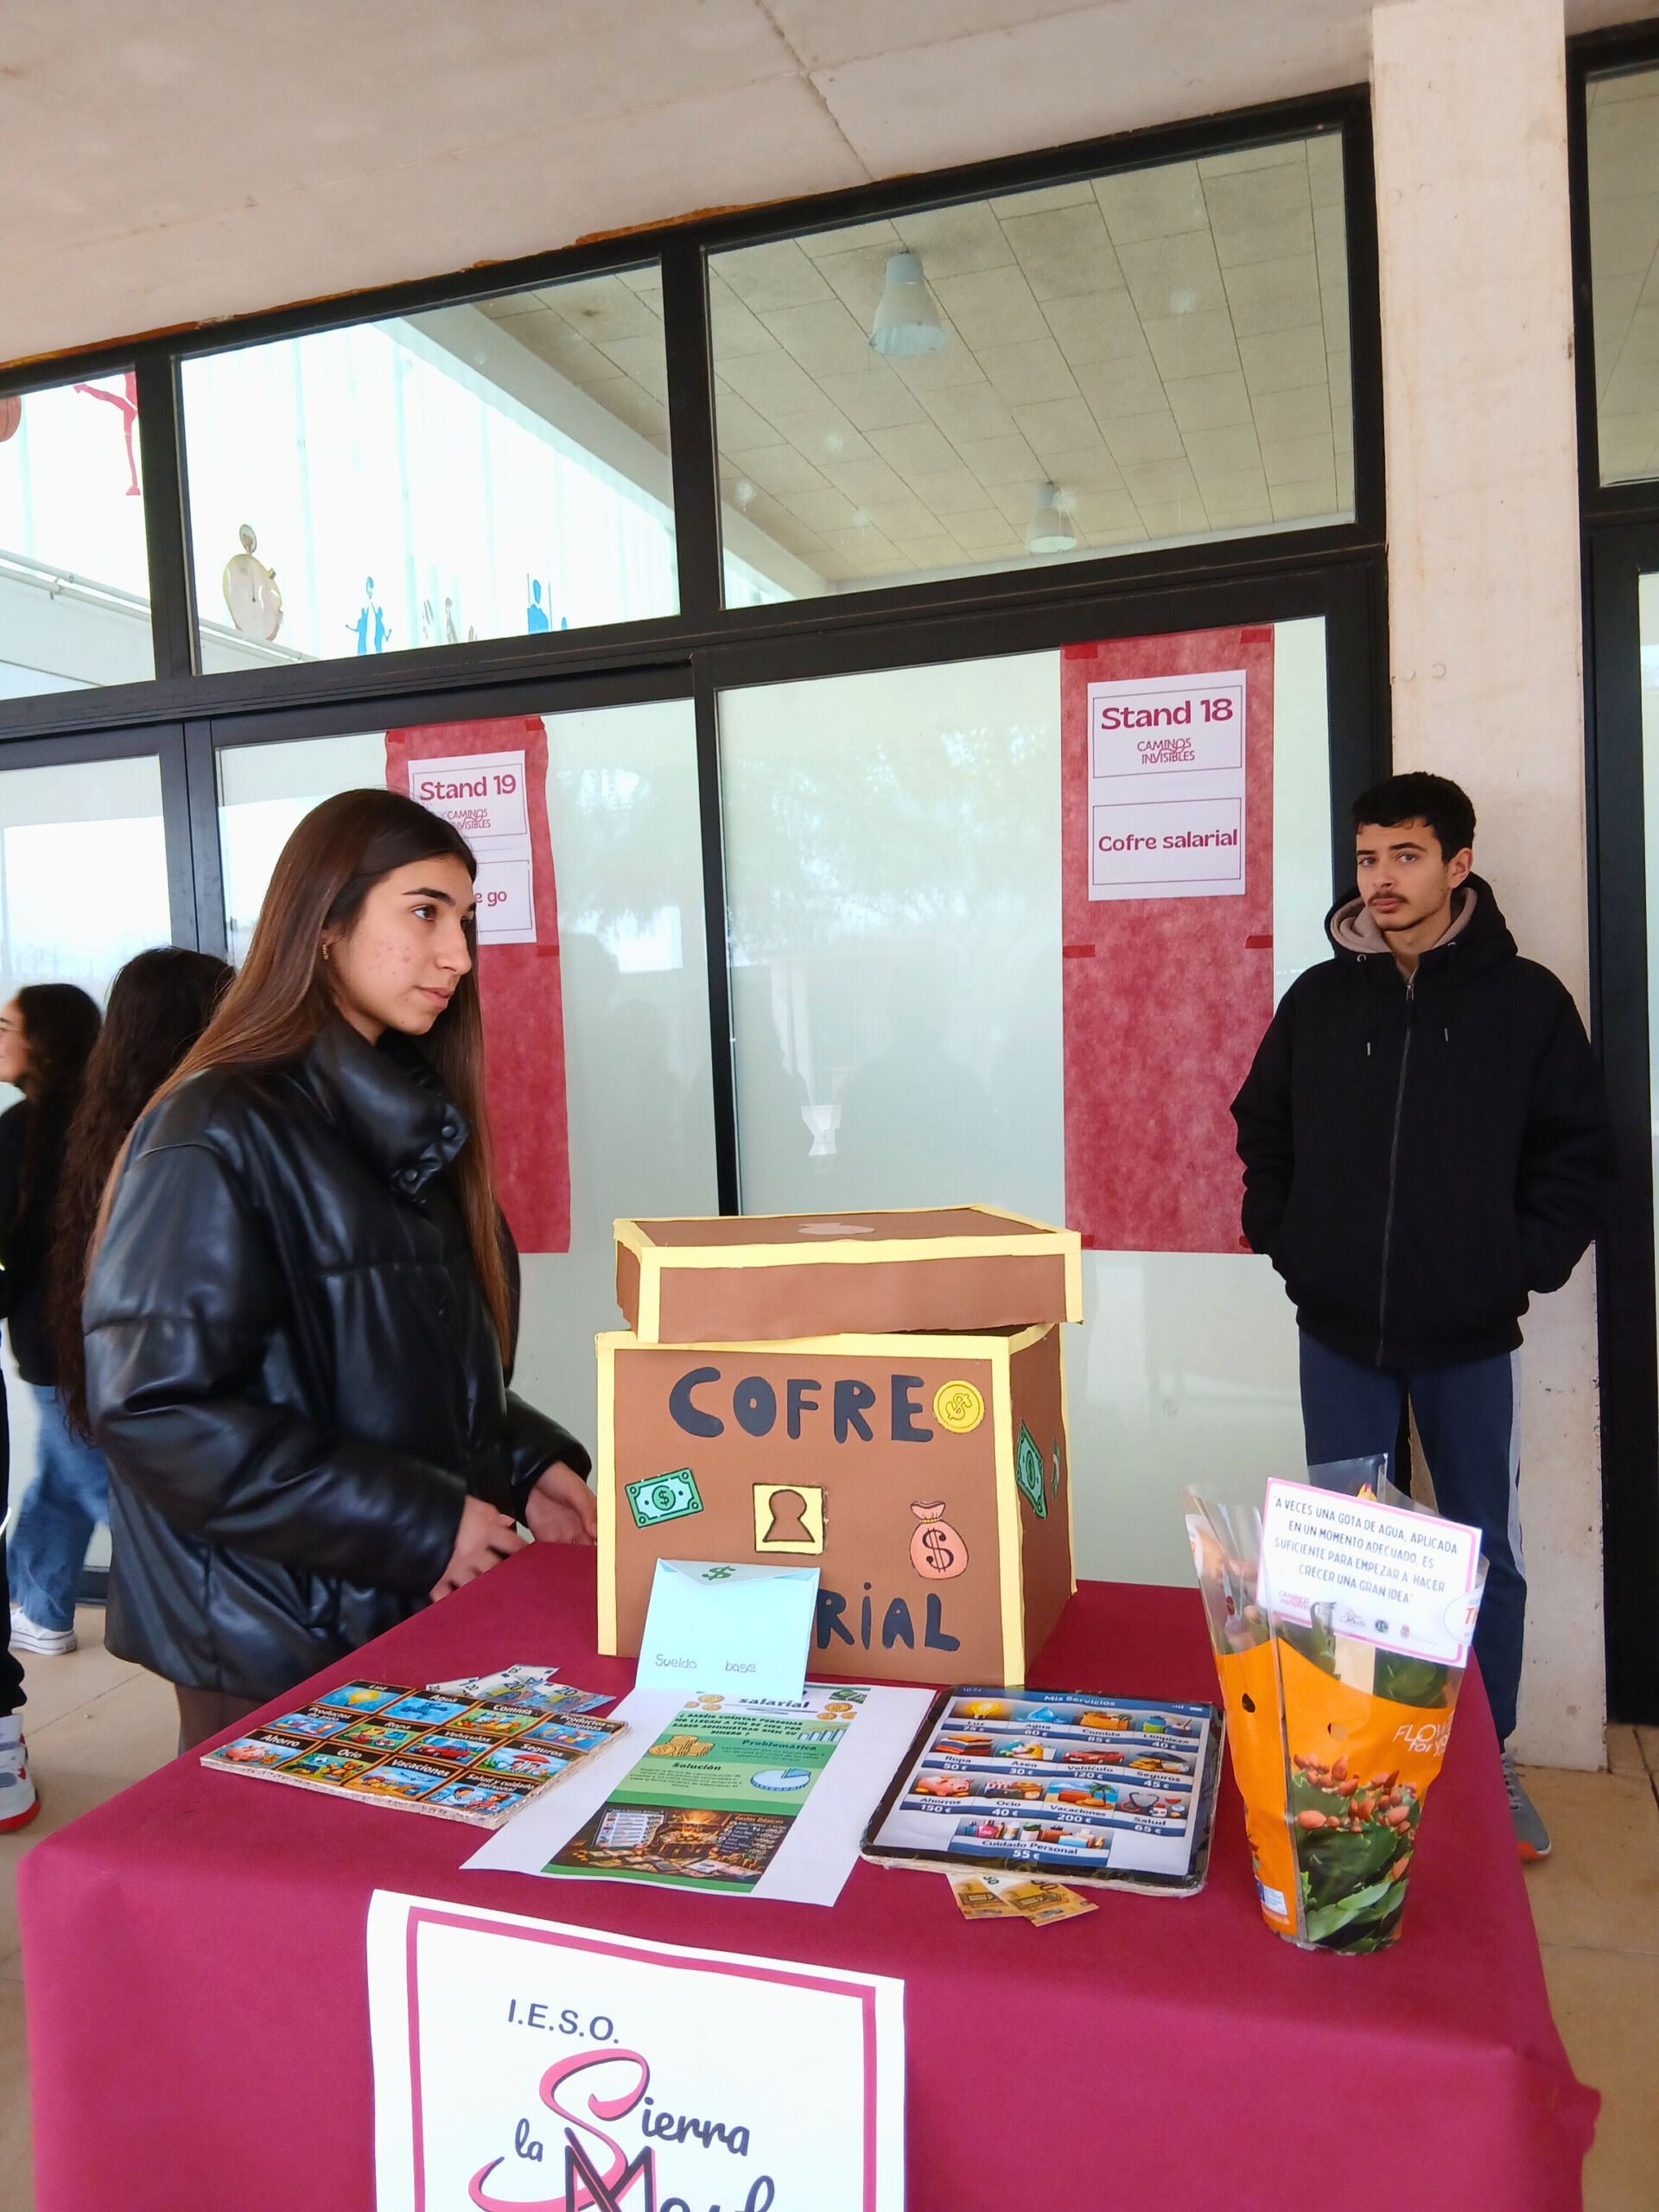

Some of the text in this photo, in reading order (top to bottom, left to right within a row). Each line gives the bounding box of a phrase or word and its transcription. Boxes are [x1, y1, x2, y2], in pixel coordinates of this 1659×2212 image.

[1101, 698, 1233, 730] Stand 18
[1137, 737, 1192, 753] CAMINOS
[1141, 750, 1195, 765] INVISIBLES
[420, 774, 517, 801] Stand 19
[447, 808, 488, 821] CAMINOS
[1098, 829, 1237, 852] Cofre salarial
[487, 891, 507, 907] go
[669, 1366, 934, 1444] COFRE
[1285, 1499, 1313, 1516] VECES
[1316, 1507, 1335, 1521] UNA
[1338, 1513, 1362, 1529] GOTA
[1364, 1519, 1376, 1532] DE
[1410, 1533, 1458, 1554] APLICADA
[1288, 1521, 1301, 1532] EN
[1304, 1525, 1317, 1536] UN
[1319, 1529, 1363, 1549] MOMENTO
[1422, 1555, 1433, 1569] ES
[1274, 1537, 1446, 1592] SUFICIENTE PARA EMPEZAR A HACER
[1299, 1564, 1335, 1582] CRECER
[1338, 1575, 1357, 1589] UNA
[1359, 1580, 1386, 1598] GRAN
[655, 1653, 756, 1673] Sueldo base
[504, 1680, 526, 1691] 20
[554, 1686, 579, 1696] 20
[429, 1694, 458, 1703] Agua
[738, 1697, 810, 1708] salarial
[1066, 1695, 1116, 1707] Servicios
[308, 1707, 352, 1719] Productos
[493, 1703, 533, 1715] Comida
[560, 1714, 606, 1727] Productos
[564, 1720, 602, 1732] limpieza
[260, 1734, 300, 1747] Ahorro
[337, 1749, 362, 1758] Ocio
[520, 1743, 563, 1758] Seguros
[672, 1762, 721, 1770] Solución
[944, 1755, 972, 1764] Ropa
[391, 1758, 450, 1777] Vacaciones
[467, 1773, 494, 1784] Salud
[499, 1780, 536, 1791] cuidado
[477, 1782, 517, 1793] personal
[992, 1808, 1009, 1816] 40
[1050, 1804, 1106, 1817] Vacaciones
[1057, 1814, 1084, 1823] 200
[1134, 1816, 1166, 1827] Salud
[982, 1840, 1078, 1855] Cuidado Personal
[1012, 1849, 1031, 1859] 55
[508, 1999, 620, 2044] I.E.S.O.
[514, 2117, 543, 2162] la
